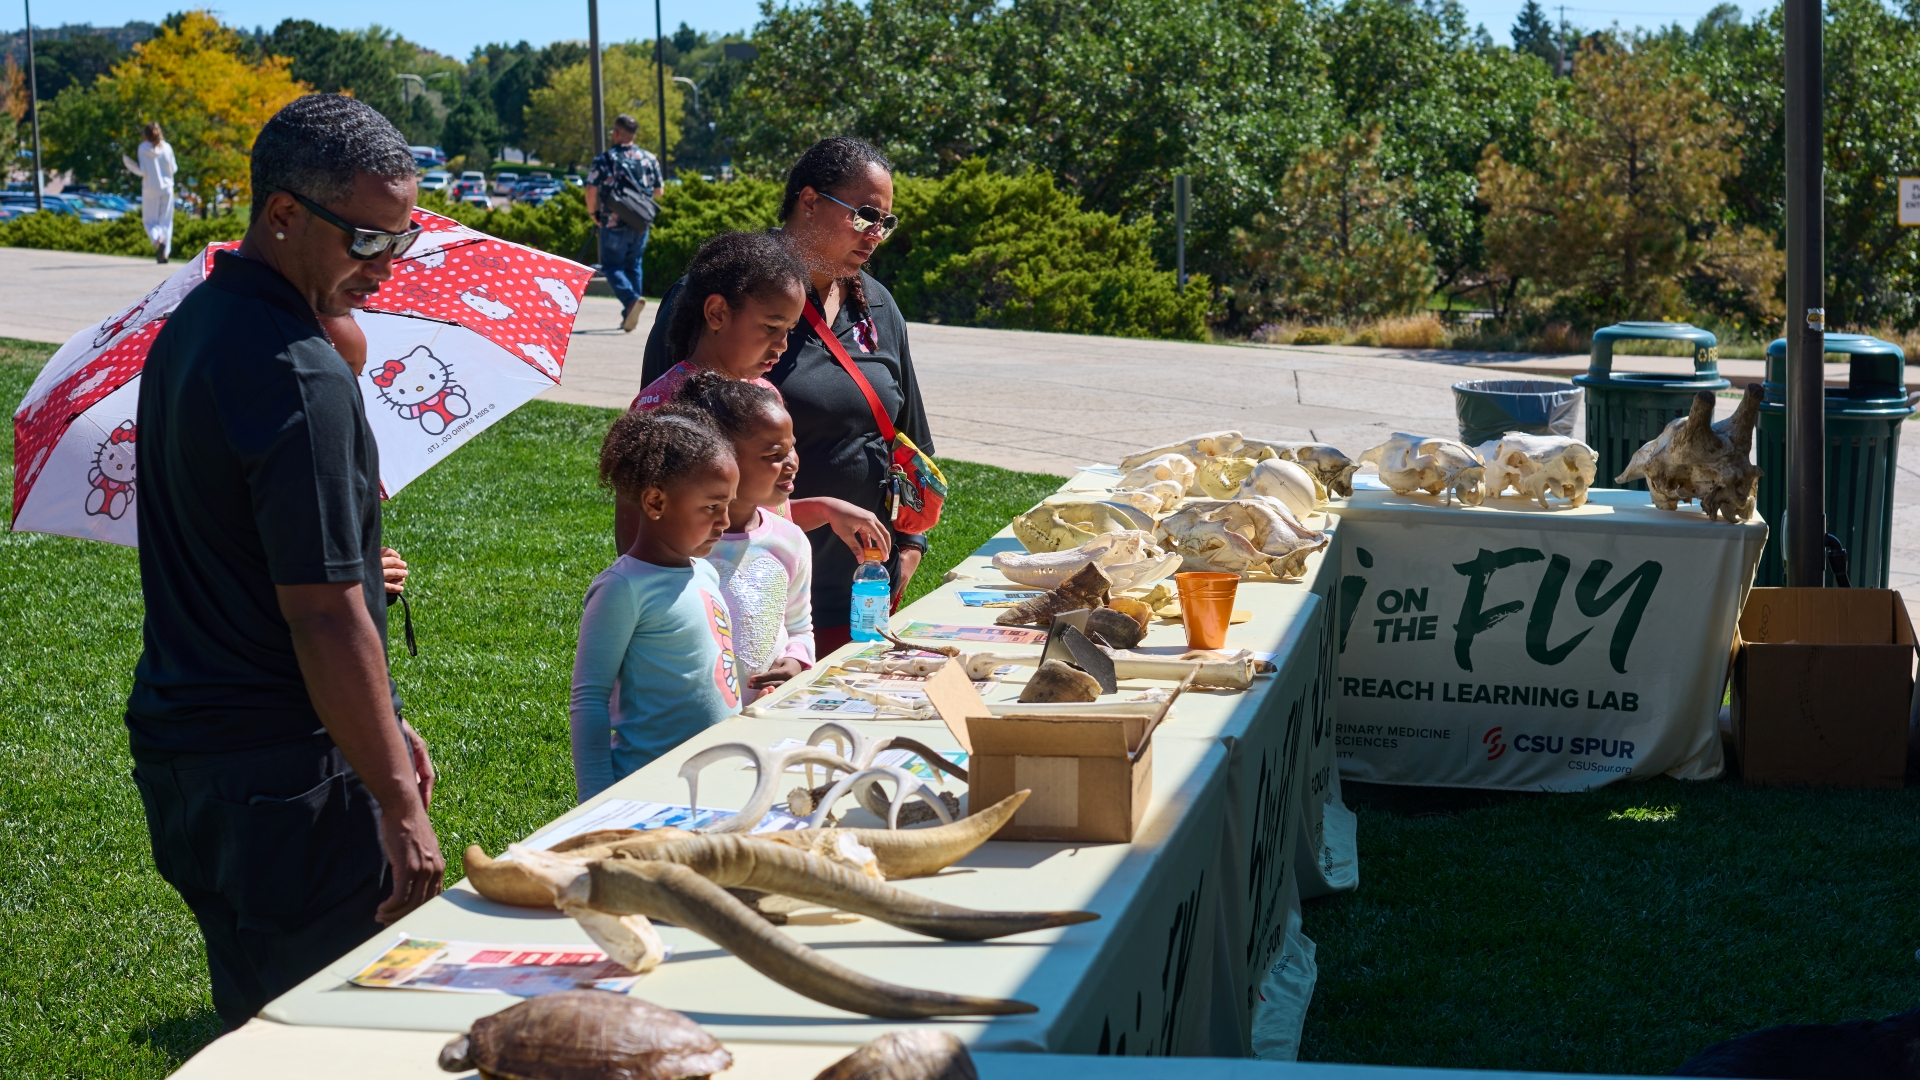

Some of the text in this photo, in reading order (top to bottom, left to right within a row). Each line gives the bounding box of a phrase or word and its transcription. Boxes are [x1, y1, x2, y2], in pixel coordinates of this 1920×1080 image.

[1376, 587, 1429, 615] ON
[1373, 615, 1439, 644] THE
[1443, 682, 1579, 708] LEARNING
[1587, 688, 1640, 712] LAB
[1335, 736, 1398, 748] SCIENCES
[1388, 726, 1451, 740] MEDICINE
[1513, 734, 1635, 760] CSU SPUR
[1567, 760, 1632, 776] CSUSpur.org
